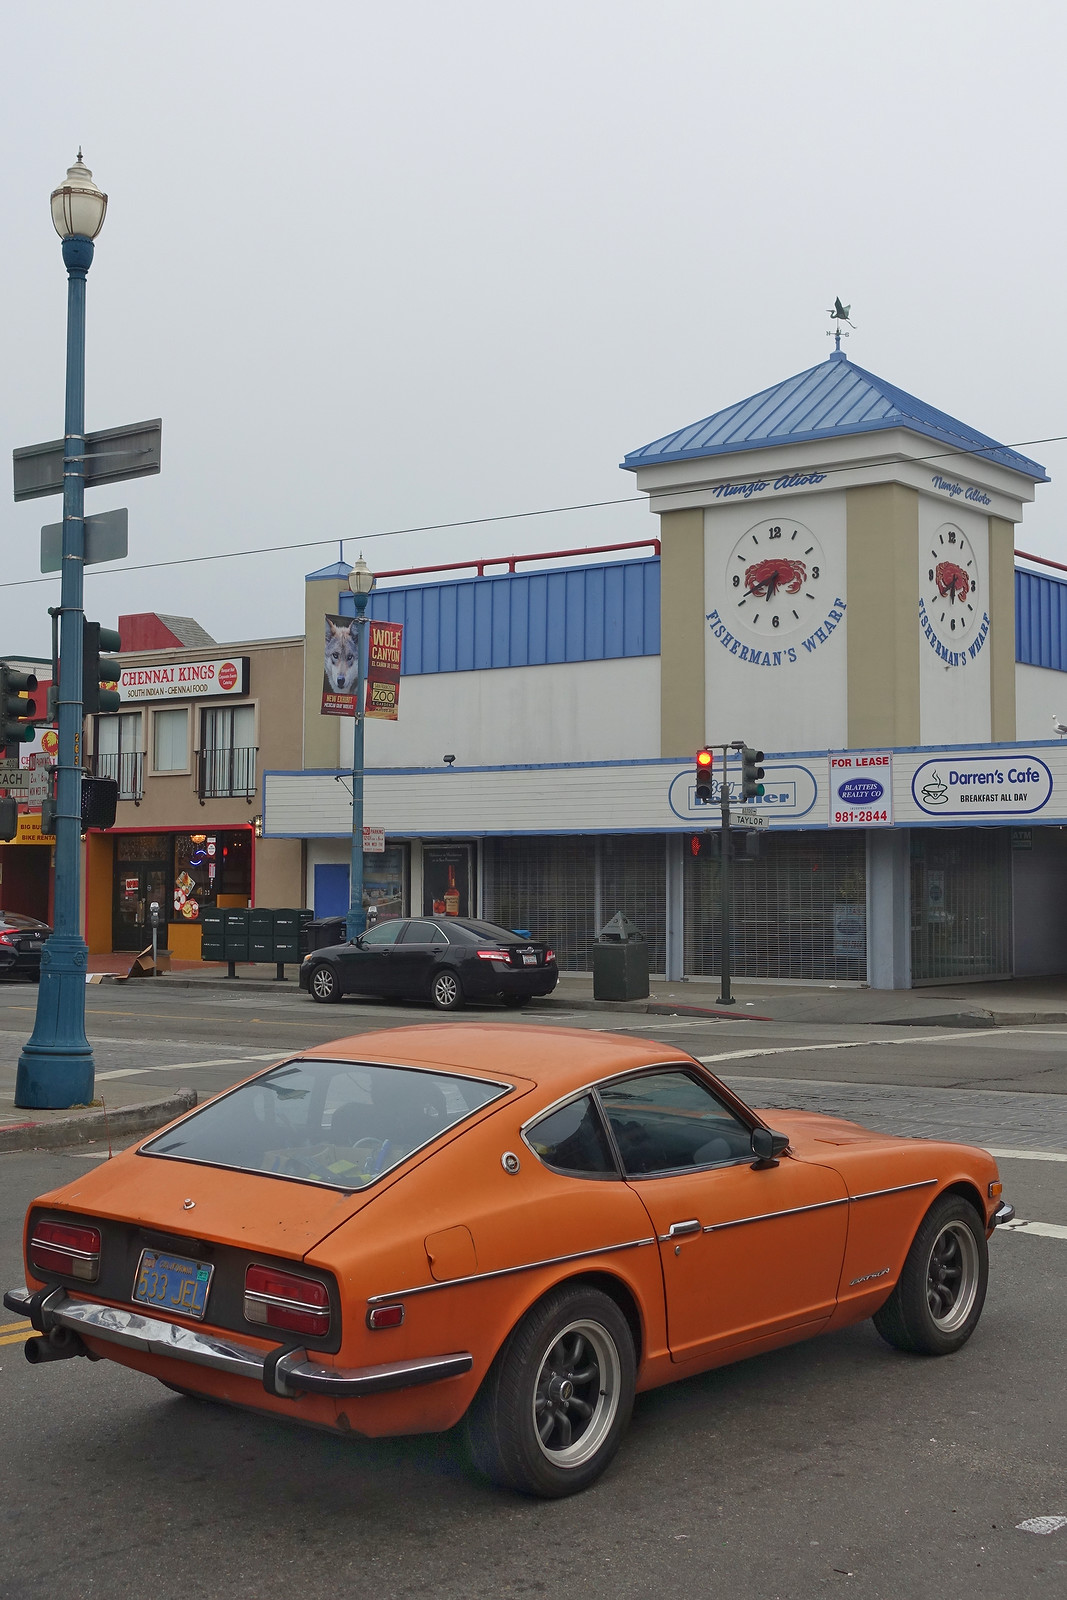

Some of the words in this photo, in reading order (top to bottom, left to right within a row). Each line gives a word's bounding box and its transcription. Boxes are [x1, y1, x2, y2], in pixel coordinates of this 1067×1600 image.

[712, 479, 770, 498] Nunzio
[773, 471, 827, 490] Alioto
[932, 475, 963, 497] Nunzio
[965, 487, 991, 505] Alioto
[769, 526, 781, 540] 12
[812, 566, 820, 579] 3
[732, 575, 740, 588] 9
[772, 615, 780, 628] 6
[950, 618, 956, 631] 6
[373, 628, 400, 648] WOLF
[706, 609, 797, 666] FISHERMAN'S
[801, 597, 847, 653] WHARF
[918, 597, 967, 666] FISHERMAN'S
[968, 612, 990, 659] WHARF
[372, 646, 399, 663] CANYON
[121, 668, 174, 686] CHENNAI
[178, 664, 215, 682] KINGS
[127, 689, 145, 698] SOUTH
[145, 687, 164, 697] INDIAN
[167, 686, 192, 695] CHENNAI
[193, 684, 208, 693] FOOD
[373, 691, 394, 702] ZOO
[831, 758, 852, 768] FOR
[856, 756, 889, 767] LEASE
[0, 773, 22, 784] ACH
[949, 769, 1004, 785] Darren's
[1007, 767, 1040, 784] Cafe
[844, 783, 878, 791] BLATTEIS
[960, 794, 998, 803] BREAKFAST
[1000, 794, 1012, 802] ALL
[1014, 793, 1028, 801] DAY
[737, 816, 763, 825] TAYLOR
[835, 810, 887, 823] 981-2844
[160, 1260, 193, 1275] CALIFORNIA
[139, 1269, 168, 1300] 533
[171, 1279, 201, 1311] JEL
